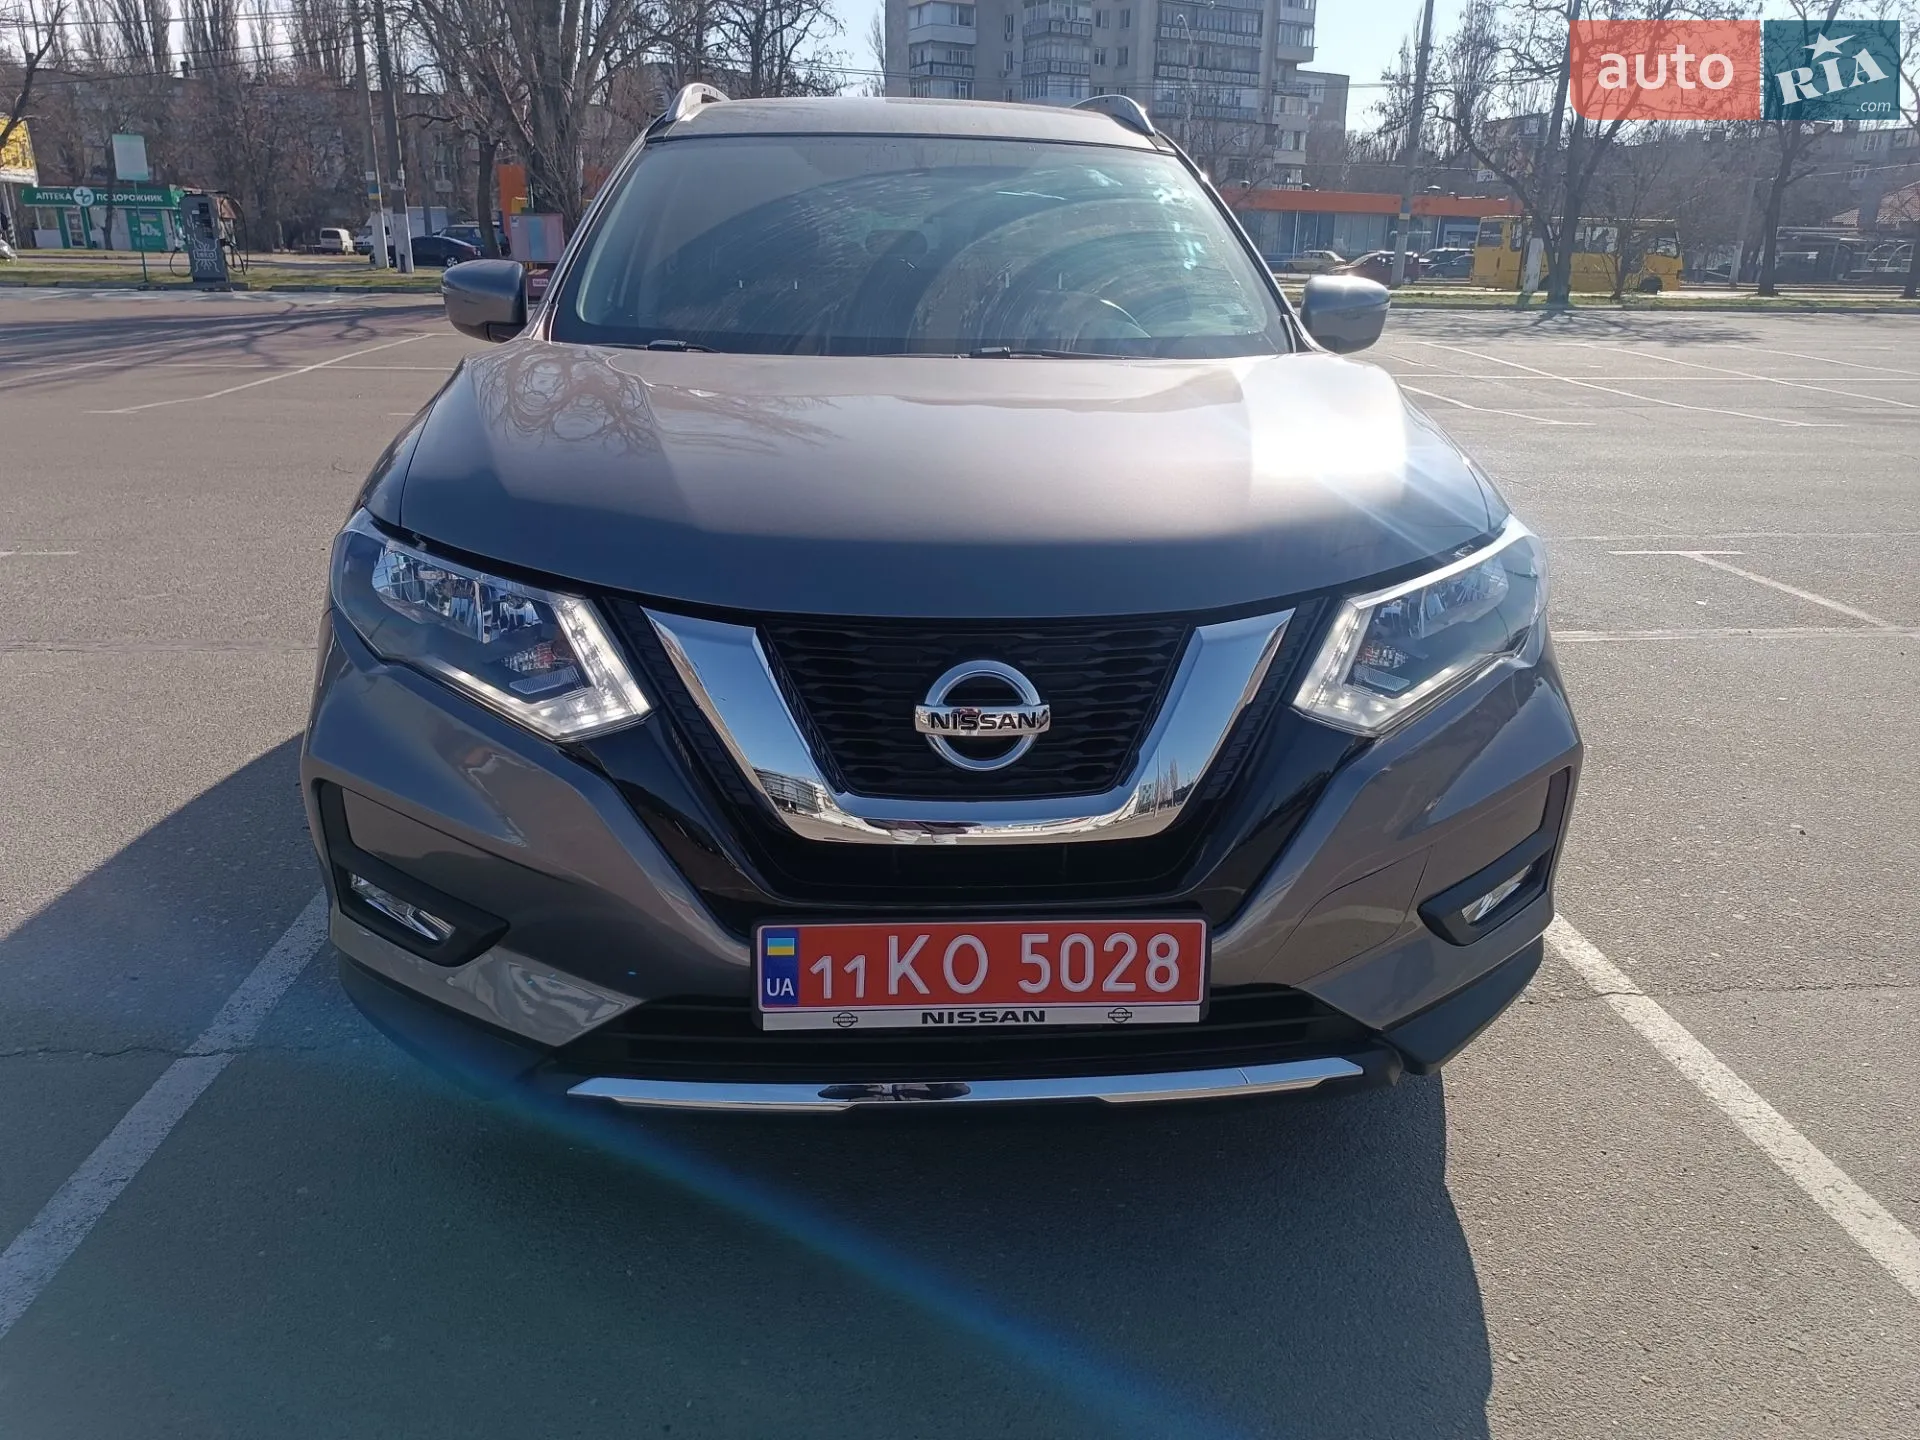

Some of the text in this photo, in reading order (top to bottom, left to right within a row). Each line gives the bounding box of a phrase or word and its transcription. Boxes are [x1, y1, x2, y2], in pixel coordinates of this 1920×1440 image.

[35, 192, 72, 201] АПТЕКА
[930, 711, 1037, 731] NISSAN
[809, 932, 1180, 999] 11 KO 5028
[766, 977, 795, 997] UA
[921, 1010, 1046, 1025] NISSAN
